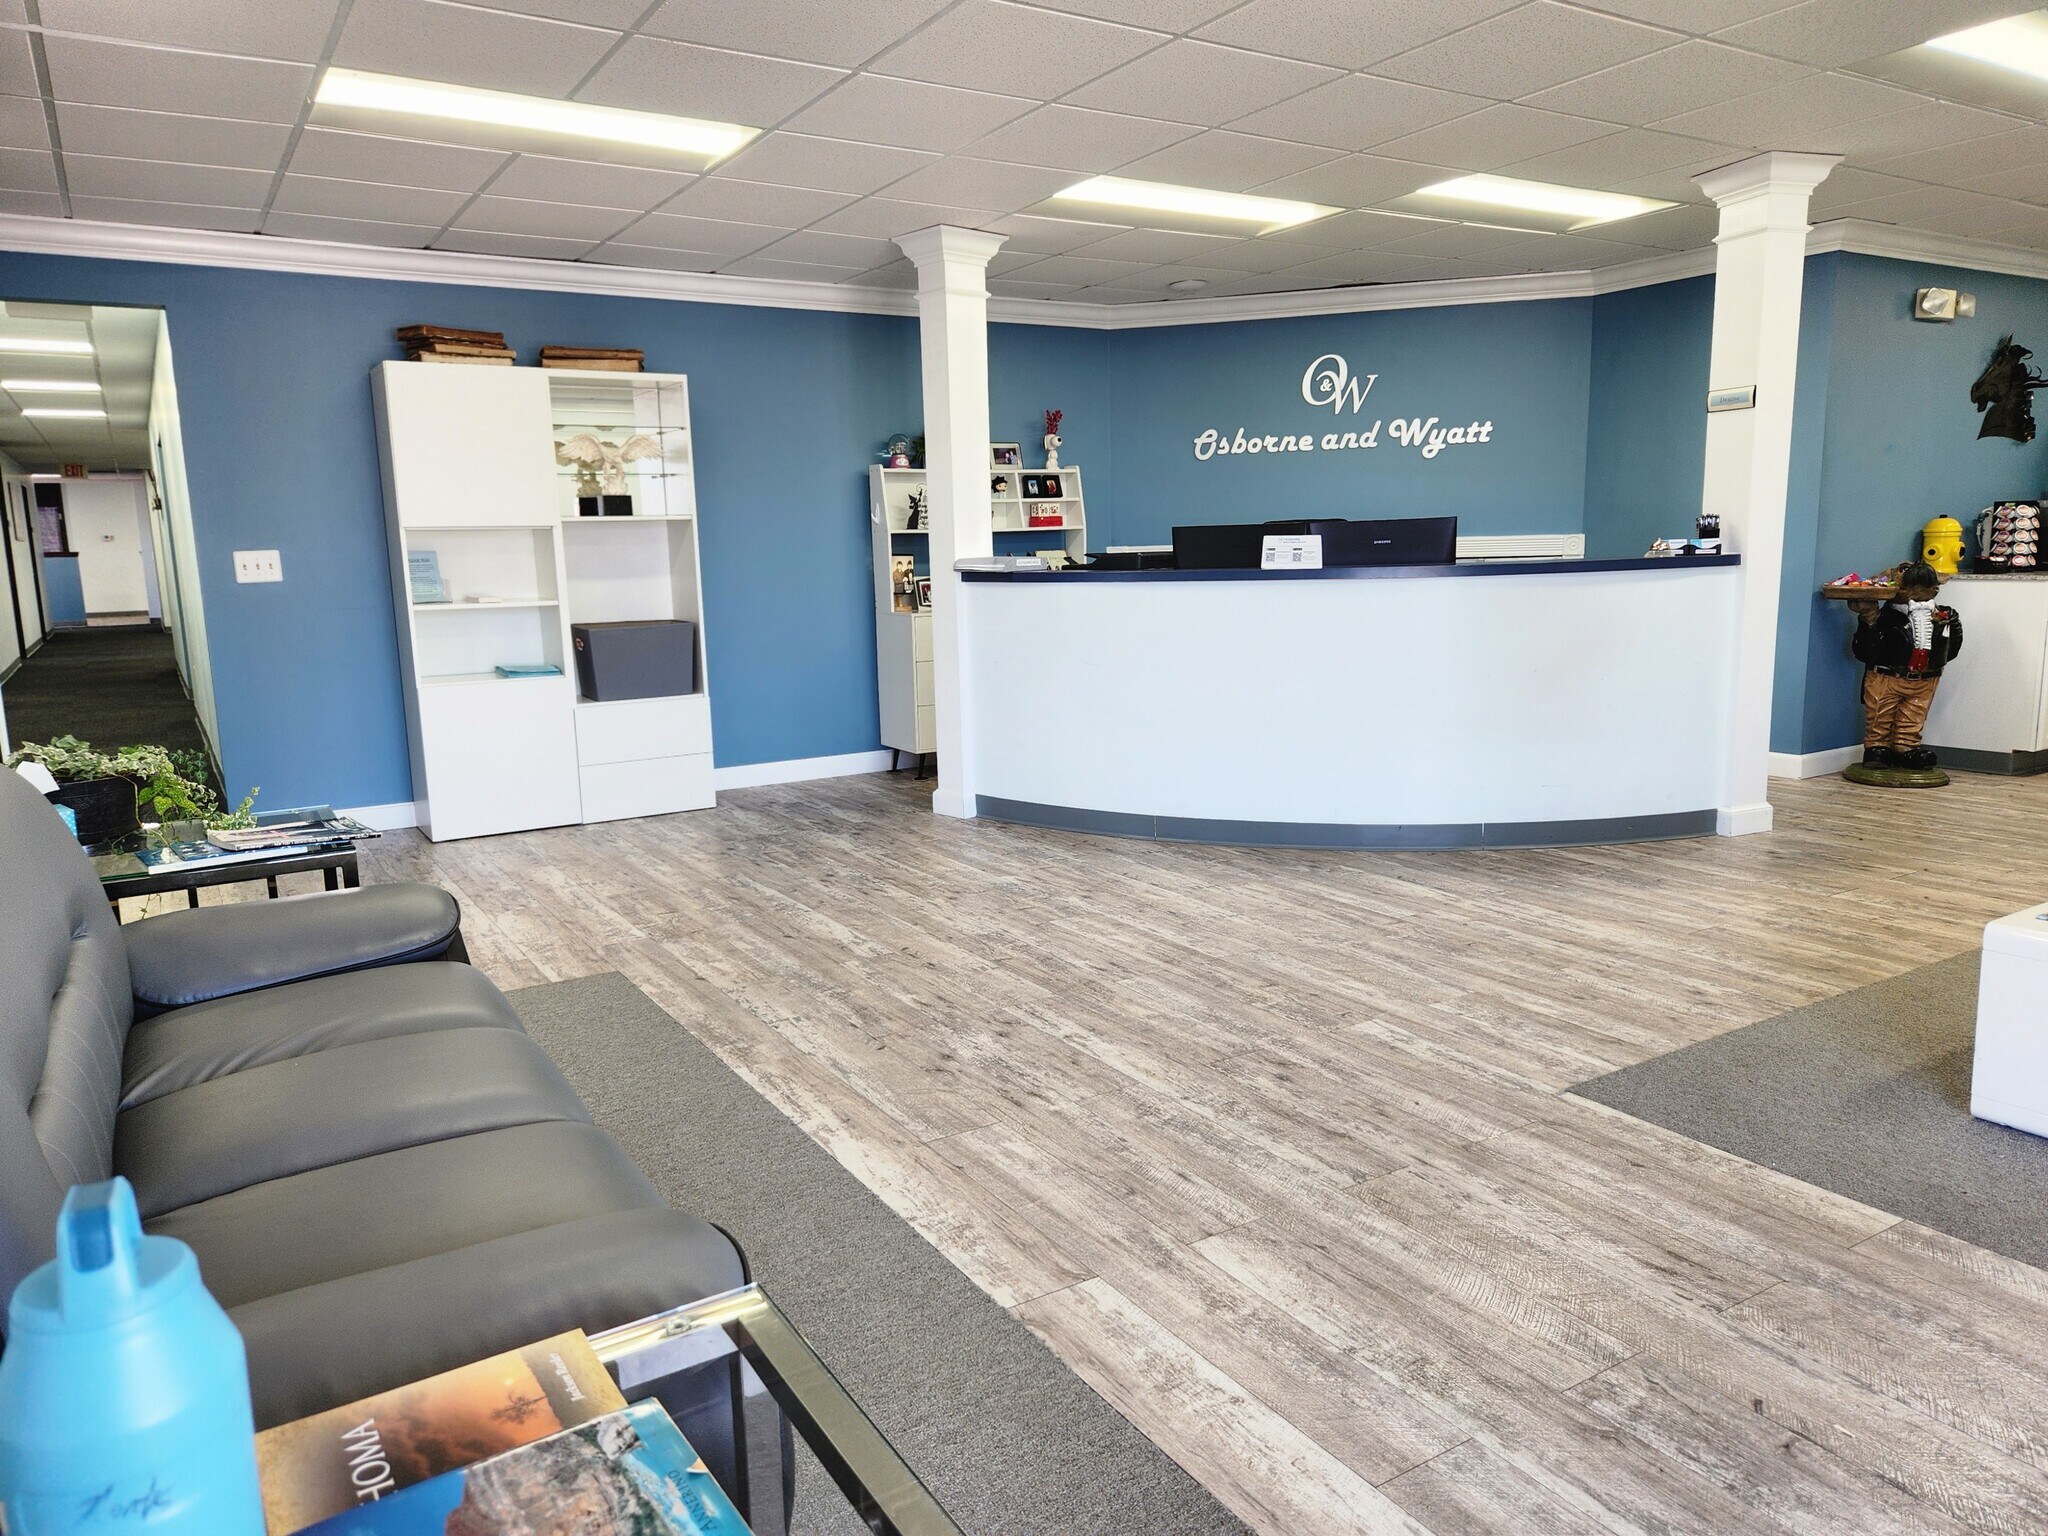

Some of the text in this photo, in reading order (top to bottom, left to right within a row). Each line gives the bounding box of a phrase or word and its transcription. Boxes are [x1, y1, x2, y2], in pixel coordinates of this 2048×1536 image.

[1194, 416, 1494, 461] Osborne and Wyatt
[64, 463, 83, 477] EXIT
